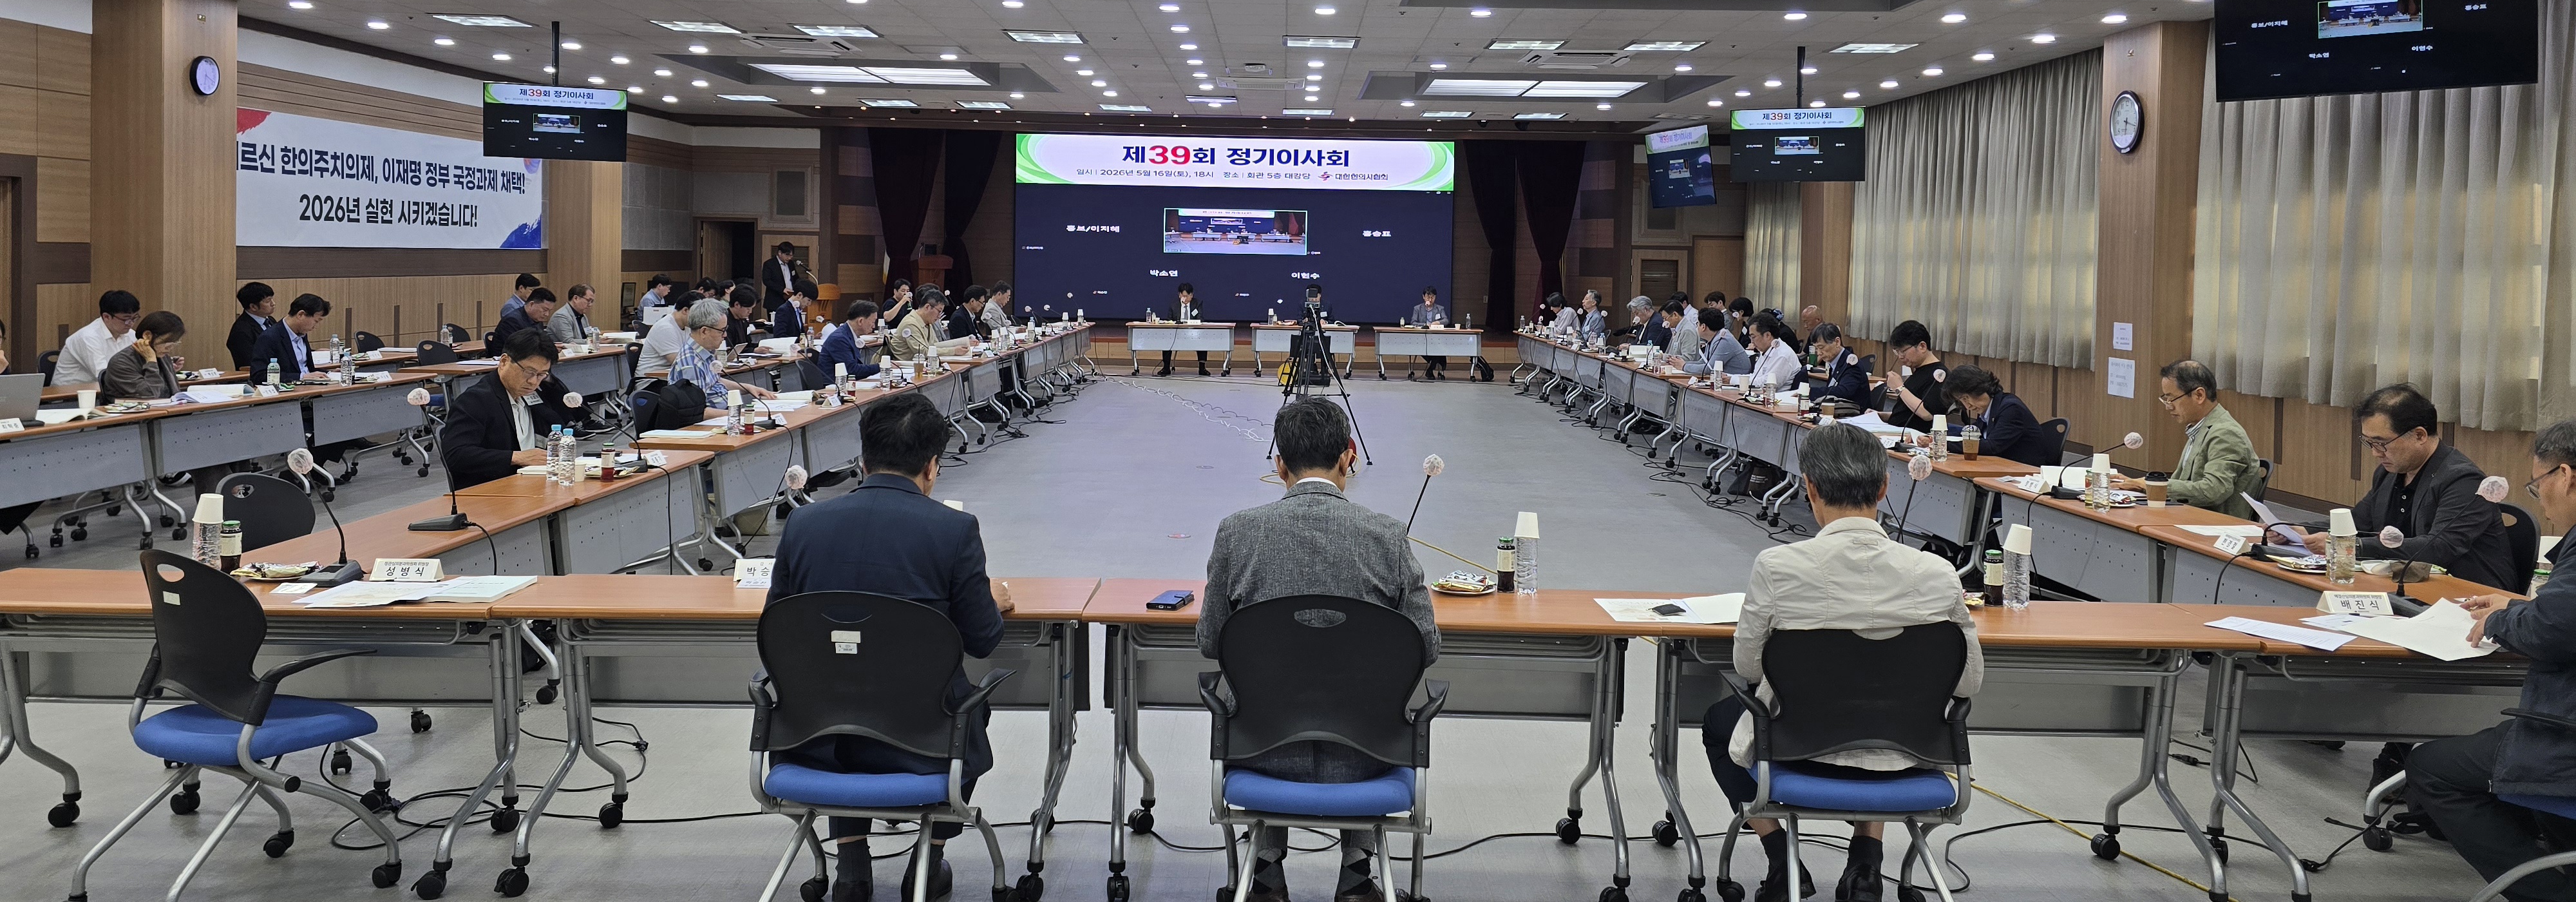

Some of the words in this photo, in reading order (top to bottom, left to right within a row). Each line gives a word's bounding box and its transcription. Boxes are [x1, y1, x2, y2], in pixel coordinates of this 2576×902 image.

[519, 88, 550, 97] 제39회
[553, 91, 594, 100] 정기이사회
[1763, 112, 1791, 121] 제39회
[1794, 111, 1832, 120] 정기이사회
[236, 140, 275, 173] 르신
[281, 146, 378, 184] 한의주치의제,
[383, 157, 422, 186] 이재명
[425, 162, 450, 187] 정부
[453, 165, 498, 193] 국정과제
[501, 171, 525, 194] 채택!
[1122, 145, 1215, 164] 제39회
[1226, 148, 1349, 167] 정기이사회
[299, 194, 361, 223] 2026년
[365, 198, 393, 224] 실현
[398, 201, 478, 227] 시키겠습니다!
